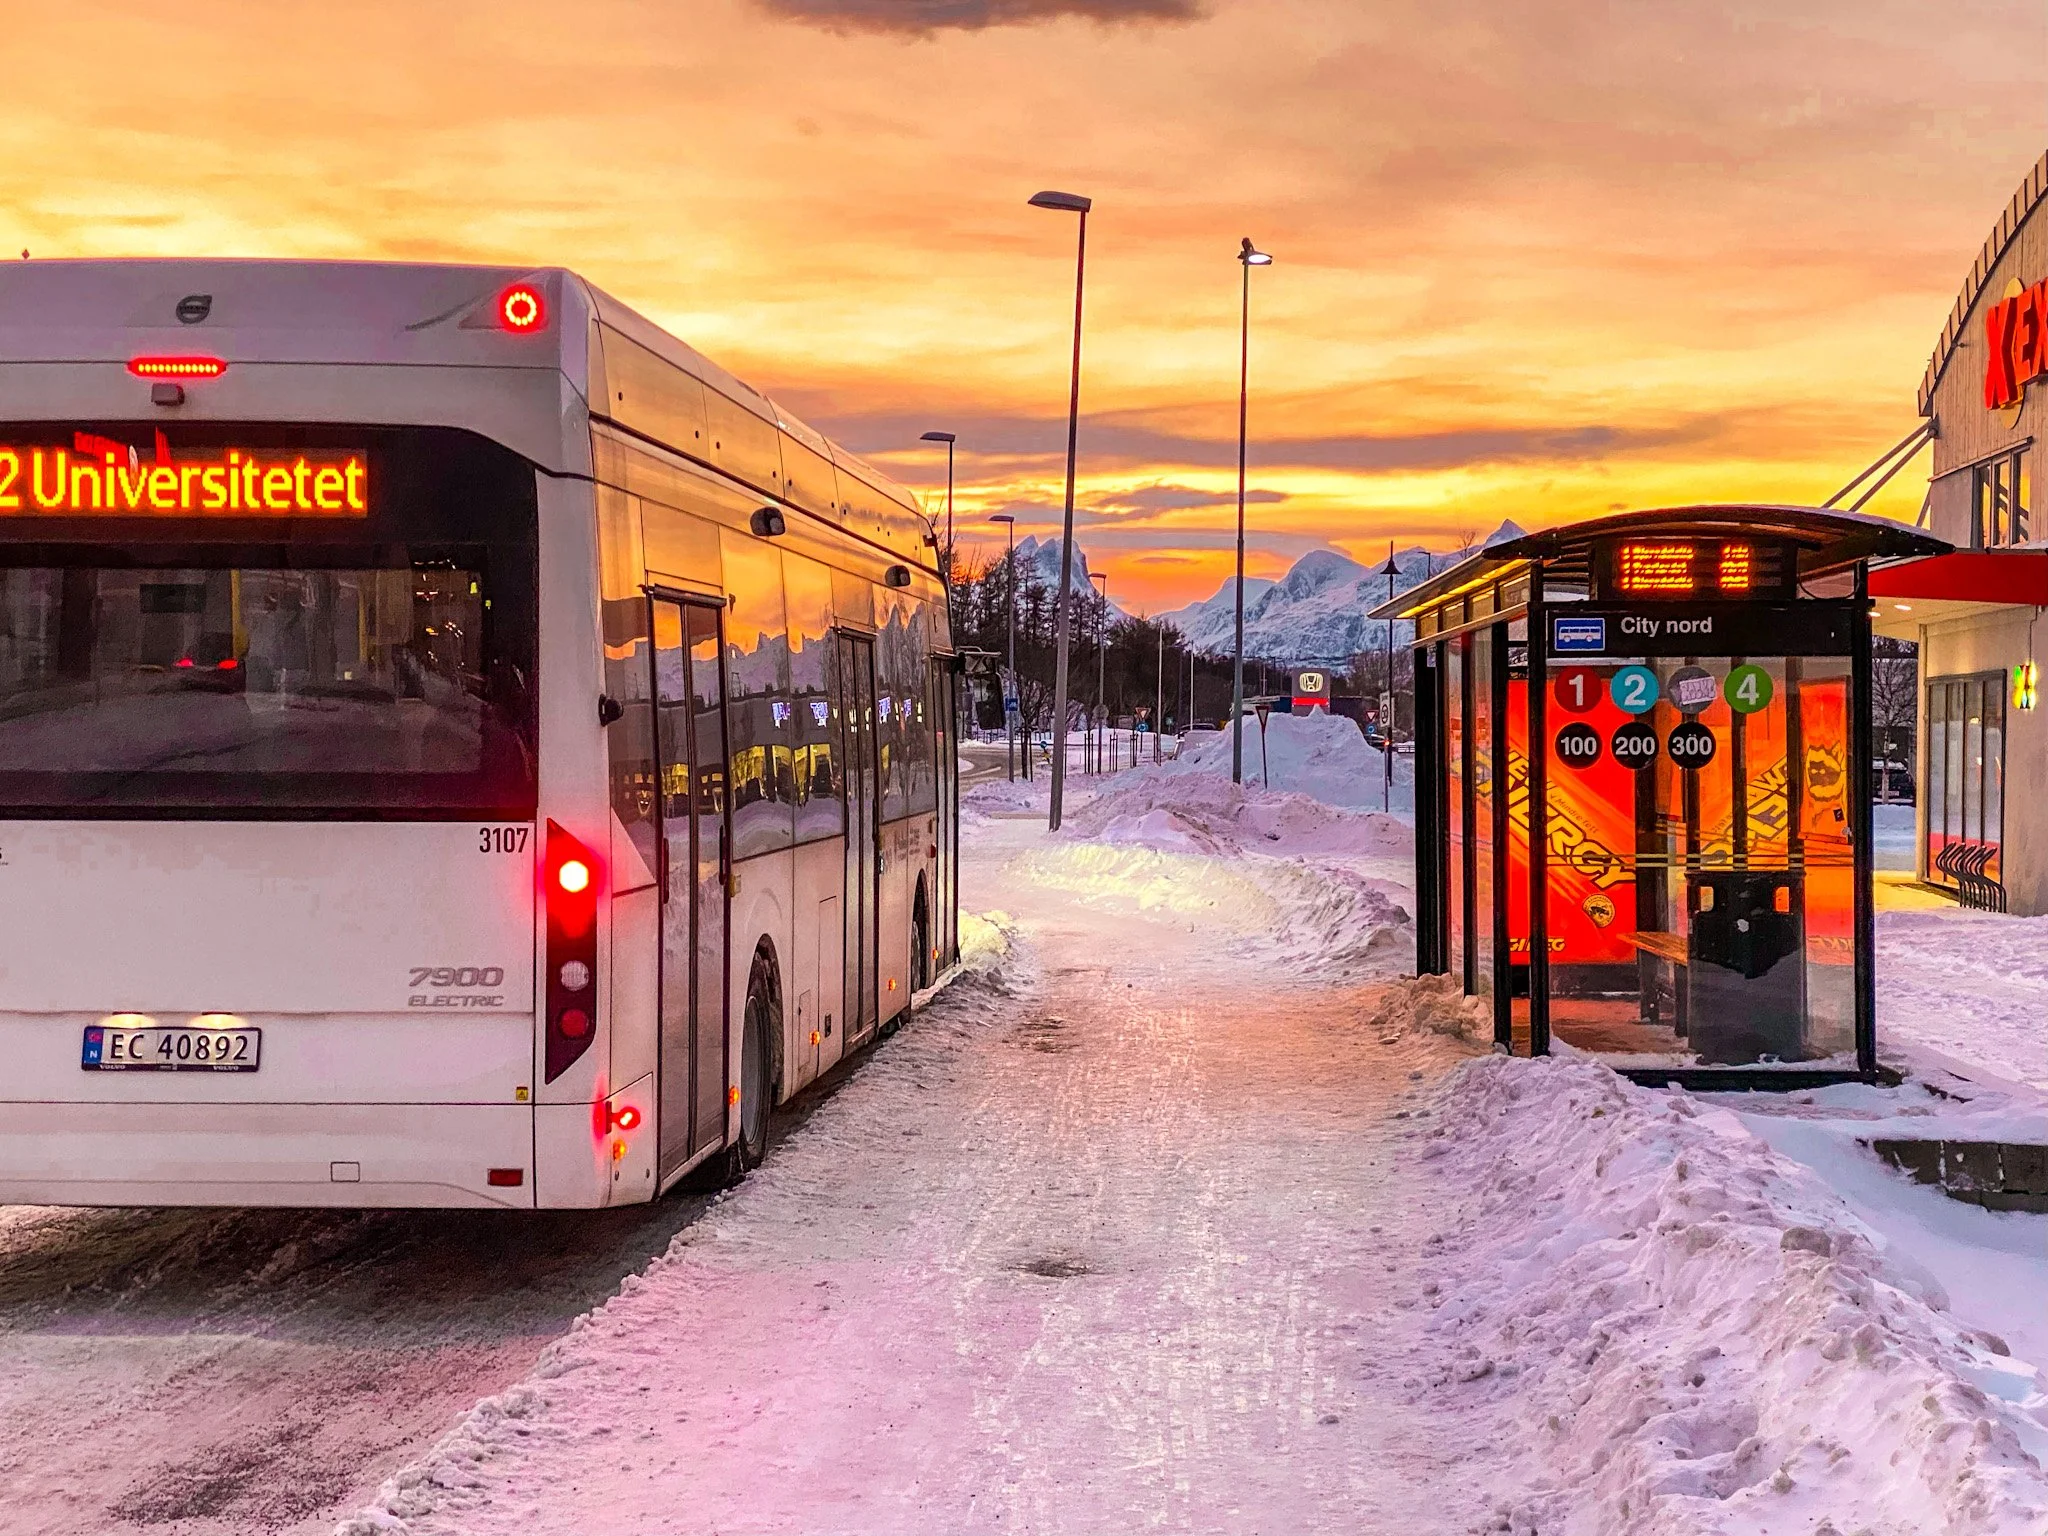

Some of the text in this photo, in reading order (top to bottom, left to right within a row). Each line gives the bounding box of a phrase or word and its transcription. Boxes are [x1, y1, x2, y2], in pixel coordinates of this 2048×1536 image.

[0, 450, 363, 508] 2 Universitetet
[1620, 616, 1712, 637] City nord
[1568, 674, 1584, 706] 1
[1624, 674, 1646, 705] 2
[1736, 673, 1760, 705] 4
[1560, 736, 1597, 755] 100
[1615, 736, 1656, 755] 200
[1671, 735, 1712, 755] 300
[479, 827, 529, 853] 3107
[409, 966, 504, 987] 7900
[408, 994, 504, 1007] ELECTRIC
[89, 1050, 98, 1059] N
[110, 1033, 248, 1061] EC 40892
[99, 1063, 127, 1071] VOLVO
[213, 1064, 240, 1072] VOLVO
